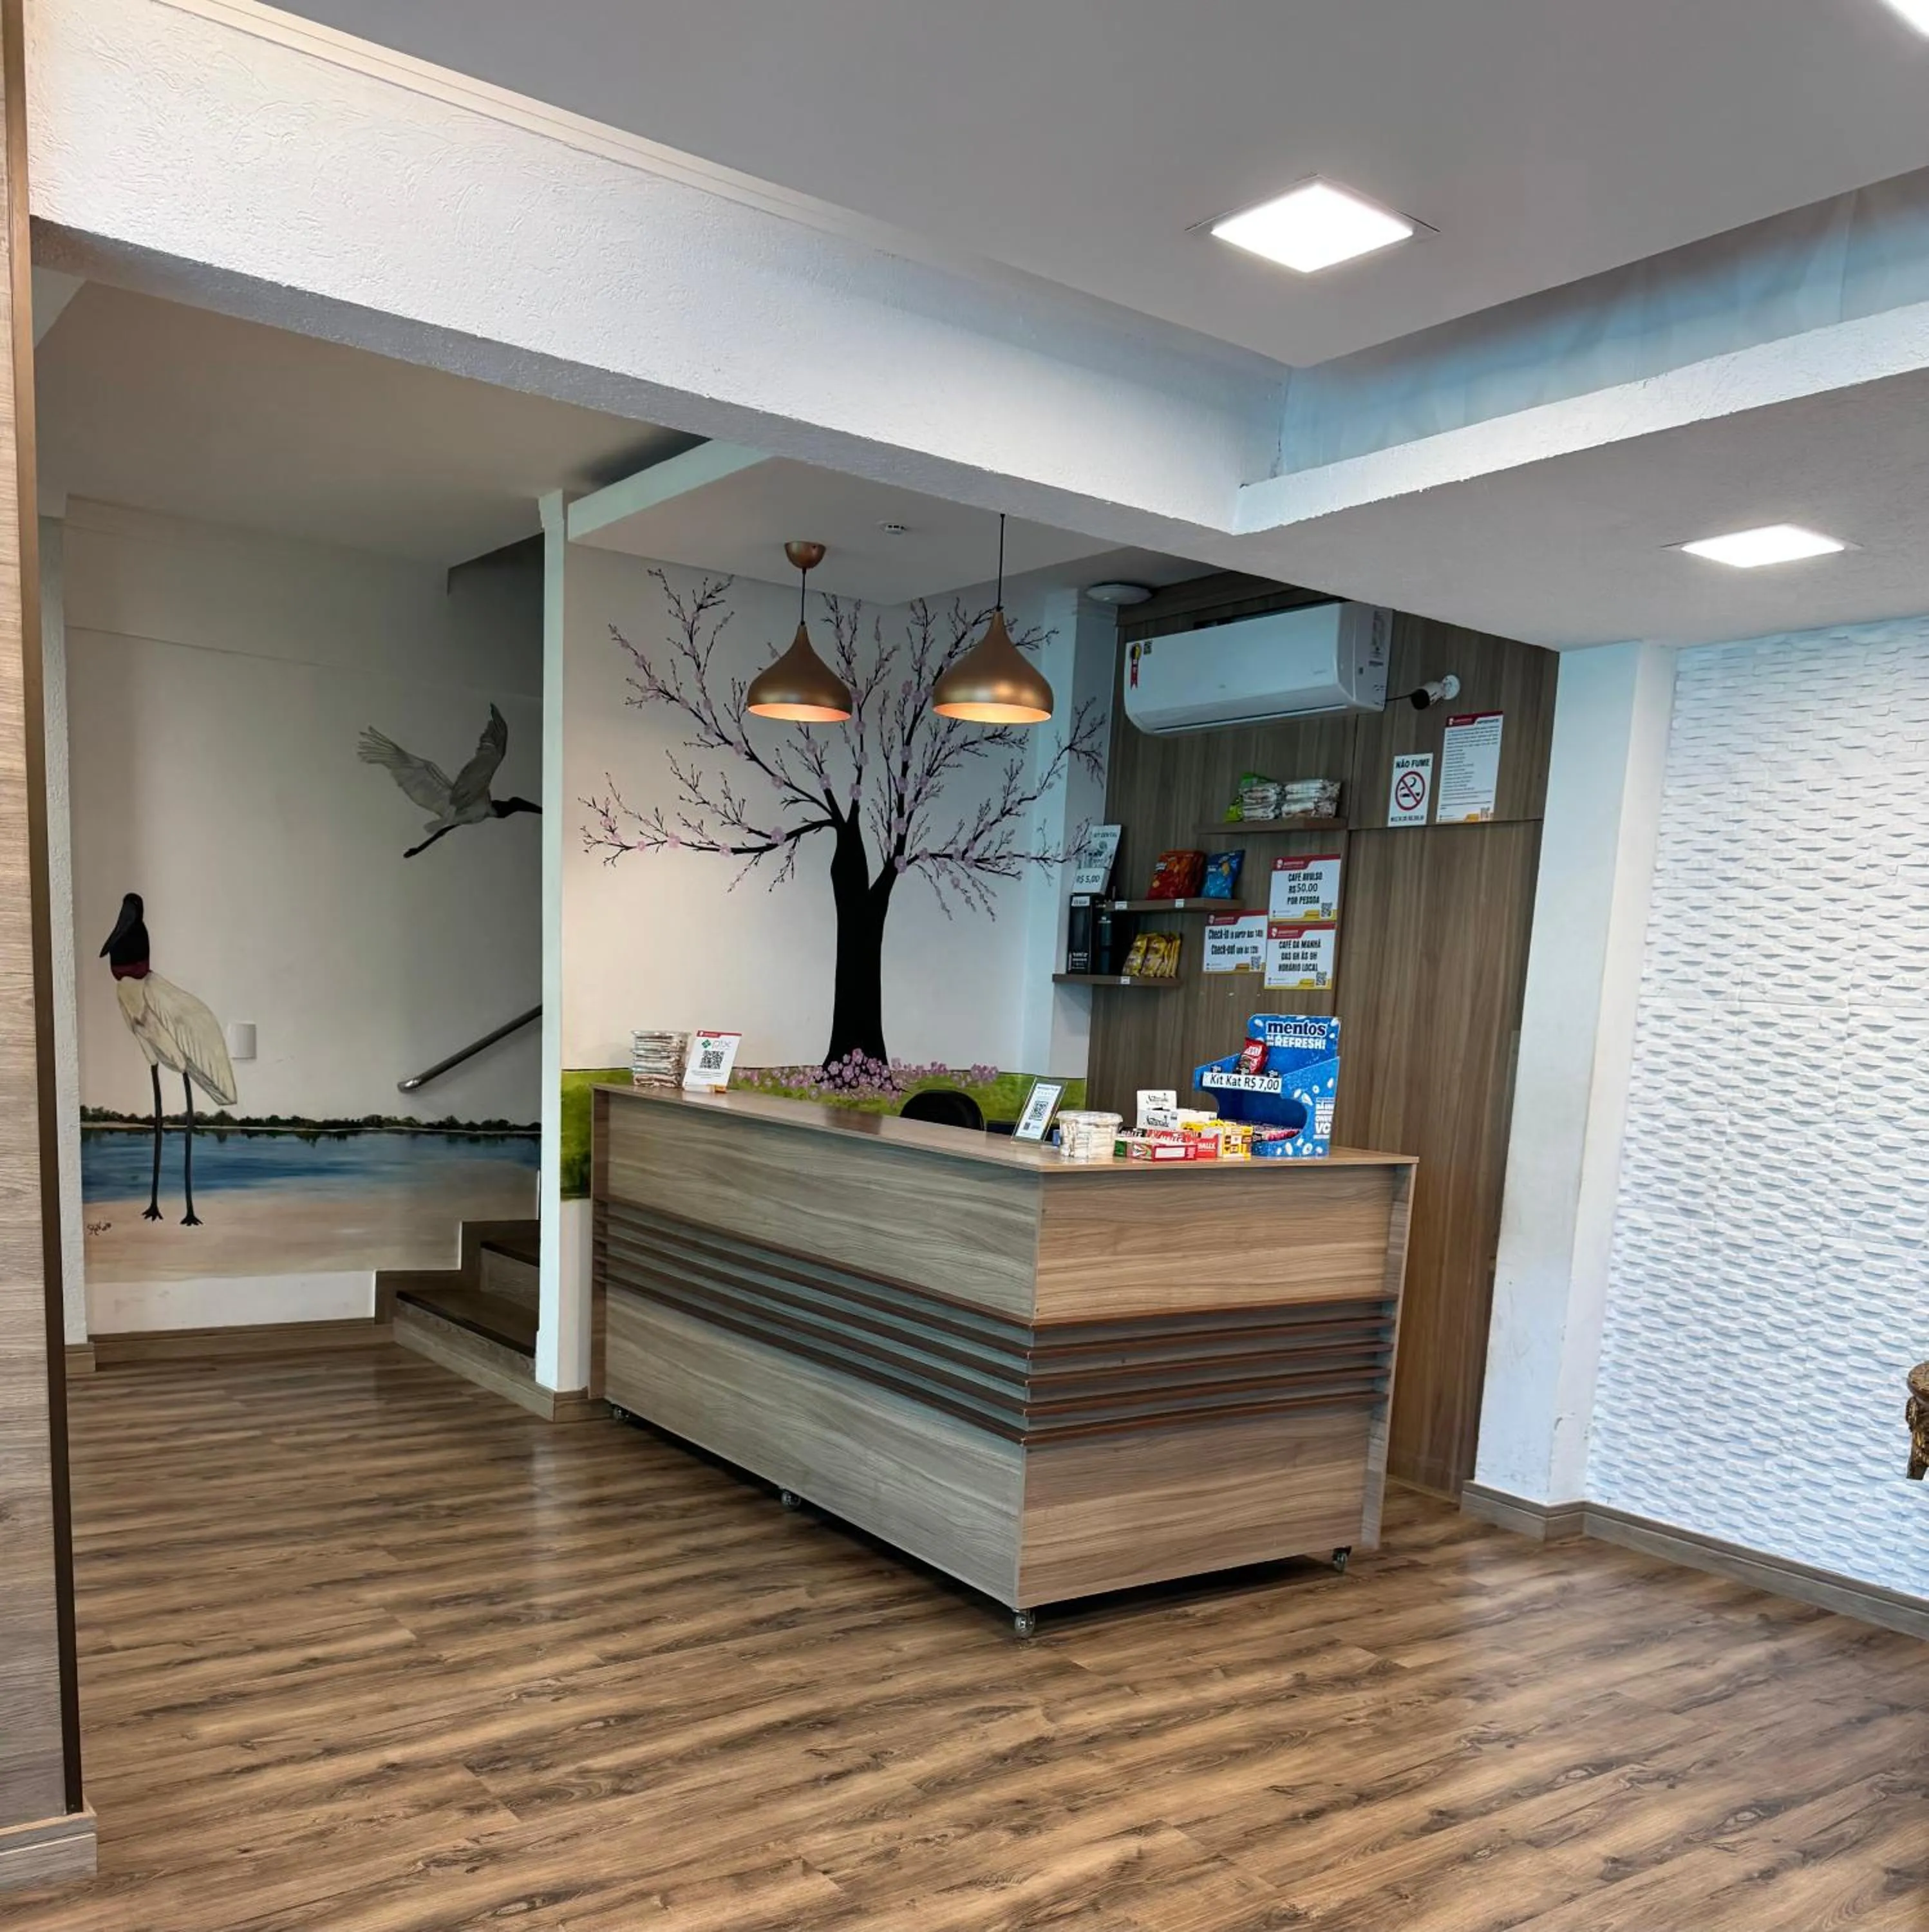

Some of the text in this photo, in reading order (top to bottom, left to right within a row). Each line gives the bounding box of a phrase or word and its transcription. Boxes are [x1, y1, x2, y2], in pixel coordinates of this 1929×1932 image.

[1396, 759, 1429, 768] NÃO FUME
[1288, 896, 1319, 905] POR PESSOA
[1302, 963, 1319, 972] LOCAL
[1266, 1021, 1327, 1037] mentos
[1210, 1074, 1280, 1091] Kit Kat R$ 7,00
